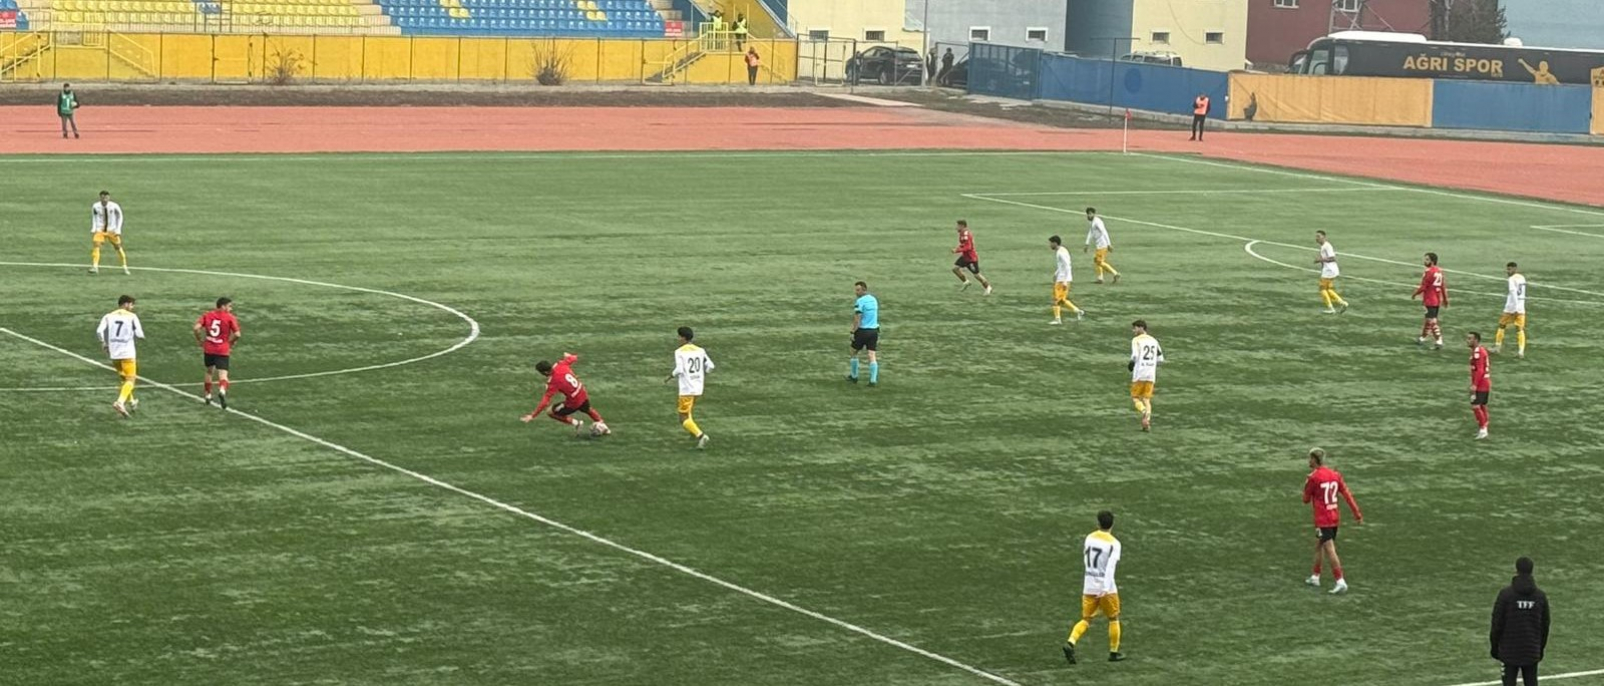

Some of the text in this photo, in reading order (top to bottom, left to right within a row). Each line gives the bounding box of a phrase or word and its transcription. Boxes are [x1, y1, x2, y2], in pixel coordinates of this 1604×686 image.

[1403, 53, 1448, 71] AĞRI
[1453, 58, 1503, 74] SPOR
[115, 320, 124, 337] 7
[210, 319, 221, 337] 5
[1143, 344, 1155, 361] 25
[687, 356, 701, 374] 20
[565, 373, 578, 388] 8
[1320, 481, 1339, 504] 72
[1085, 545, 1103, 569] 17
[1516, 600, 1536, 610] TFF
